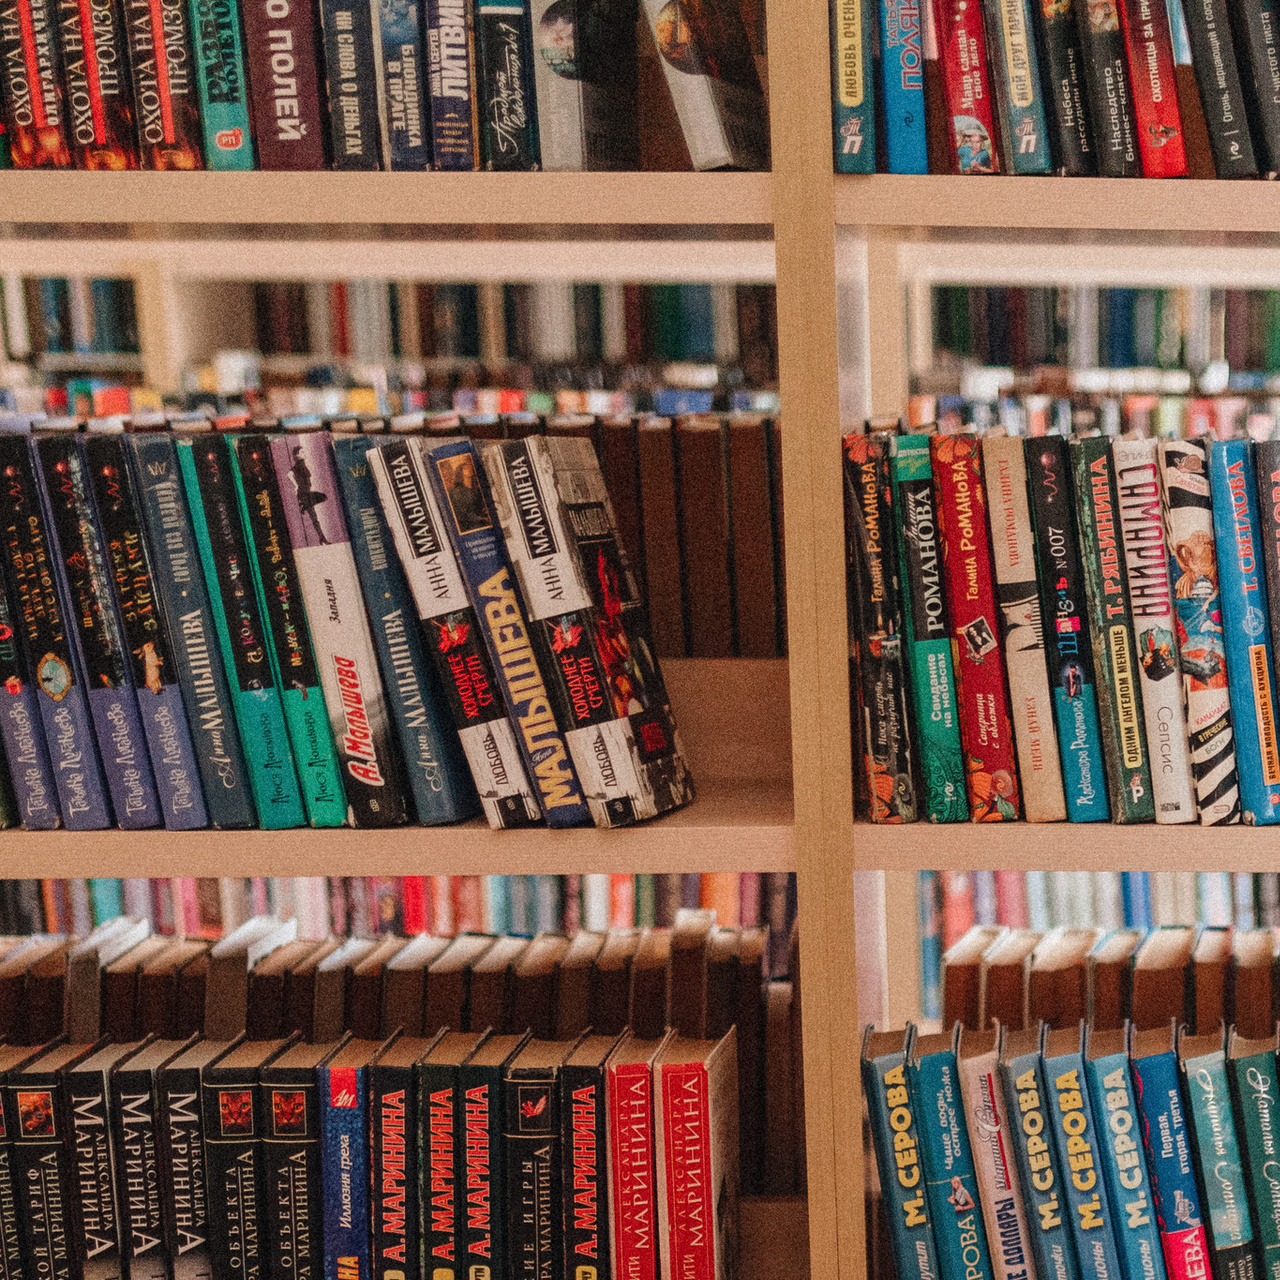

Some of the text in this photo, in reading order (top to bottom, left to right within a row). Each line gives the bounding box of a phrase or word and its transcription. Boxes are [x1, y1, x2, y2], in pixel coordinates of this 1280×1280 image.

[2, 5, 33, 125] ОХОТА НА
[58, 15, 95, 144] ОХОТА НА
[131, 13, 163, 144] ОХОТА НА
[268, 29, 306, 140] ПОЛЕЙ
[335, 11, 362, 154] НИ СЛОВА ДЕНЬГАХ
[402, 44, 421, 147] БЛОНДИНКА
[844, 39, 856, 98] ЛЮБОВЬ
[962, 75, 974, 109] Мавр
[1145, 40, 1162, 102] ОХОТНИЦЫ
[1260, 11, 1280, 89] чистого листа
[389, 78, 406, 131] ПРАГЕ
[1060, 79, 1075, 127] Небеса
[1103, 67, 1123, 151] Наследство
[390, 453, 451, 601] АННА МАЛЫШЕВА
[513, 454, 565, 602] АННА МАЛЫШЕВА
[862, 462, 878, 552] РОМАНОВА
[953, 461, 979, 600] Галина РОМАНОВА
[1091, 455, 1123, 595] РЯБИНИНА
[1228, 460, 1256, 573] СВЕТЛОВА
[914, 487, 944, 633] РОМАНОВА
[179, 608, 225, 729] МАЛЫШЕВА
[384, 608, 427, 729] МАЛЫШЕВА
[451, 653, 479, 719] ХОЛОДНЕЕ
[467, 654, 493, 708] СМЕРТИ
[479, 567, 581, 811] МАЛЫШЕВА
[560, 654, 589, 720] ХОЛОДНЕЕ
[930, 654, 942, 722] Свидание
[938, 653, 952, 708] небесах
[1114, 628, 1138, 762] ОДНИМ АНГЕЛОМ МЕНЬШЕ
[1255, 650, 1277, 779] ВЕЧНАЯ МОЛОДОСТЬ АУКЦИОНА
[482, 727, 509, 785] ЛЮБОВЬ
[1157, 706, 1174, 775] Сепсис
[884, 1065, 920, 1188] СЕРОВА
[1160, 1111, 1174, 1158] Первая,
[1246, 1067, 1275, 1156] Наталья
[27, 1168, 46, 1235] ТАРИФ
[39, 1151, 68, 1260] МАРИНИНА
[72, 1094, 116, 1259] МАРИНИНА
[121, 1092, 161, 1257] МАРИНИНА
[189, 1130, 206, 1227] АЛЕКСАНДРА
[339, 1135, 353, 1228] Иллюзия греха
[522, 1161, 533, 1224] ИГРЫ
[629, 1079, 650, 1249] МАРИНИНА
[225, 1167, 242, 1268] ОБЪЕКТА
[995, 1197, 1024, 1265] ДОЛЛАРЫ
